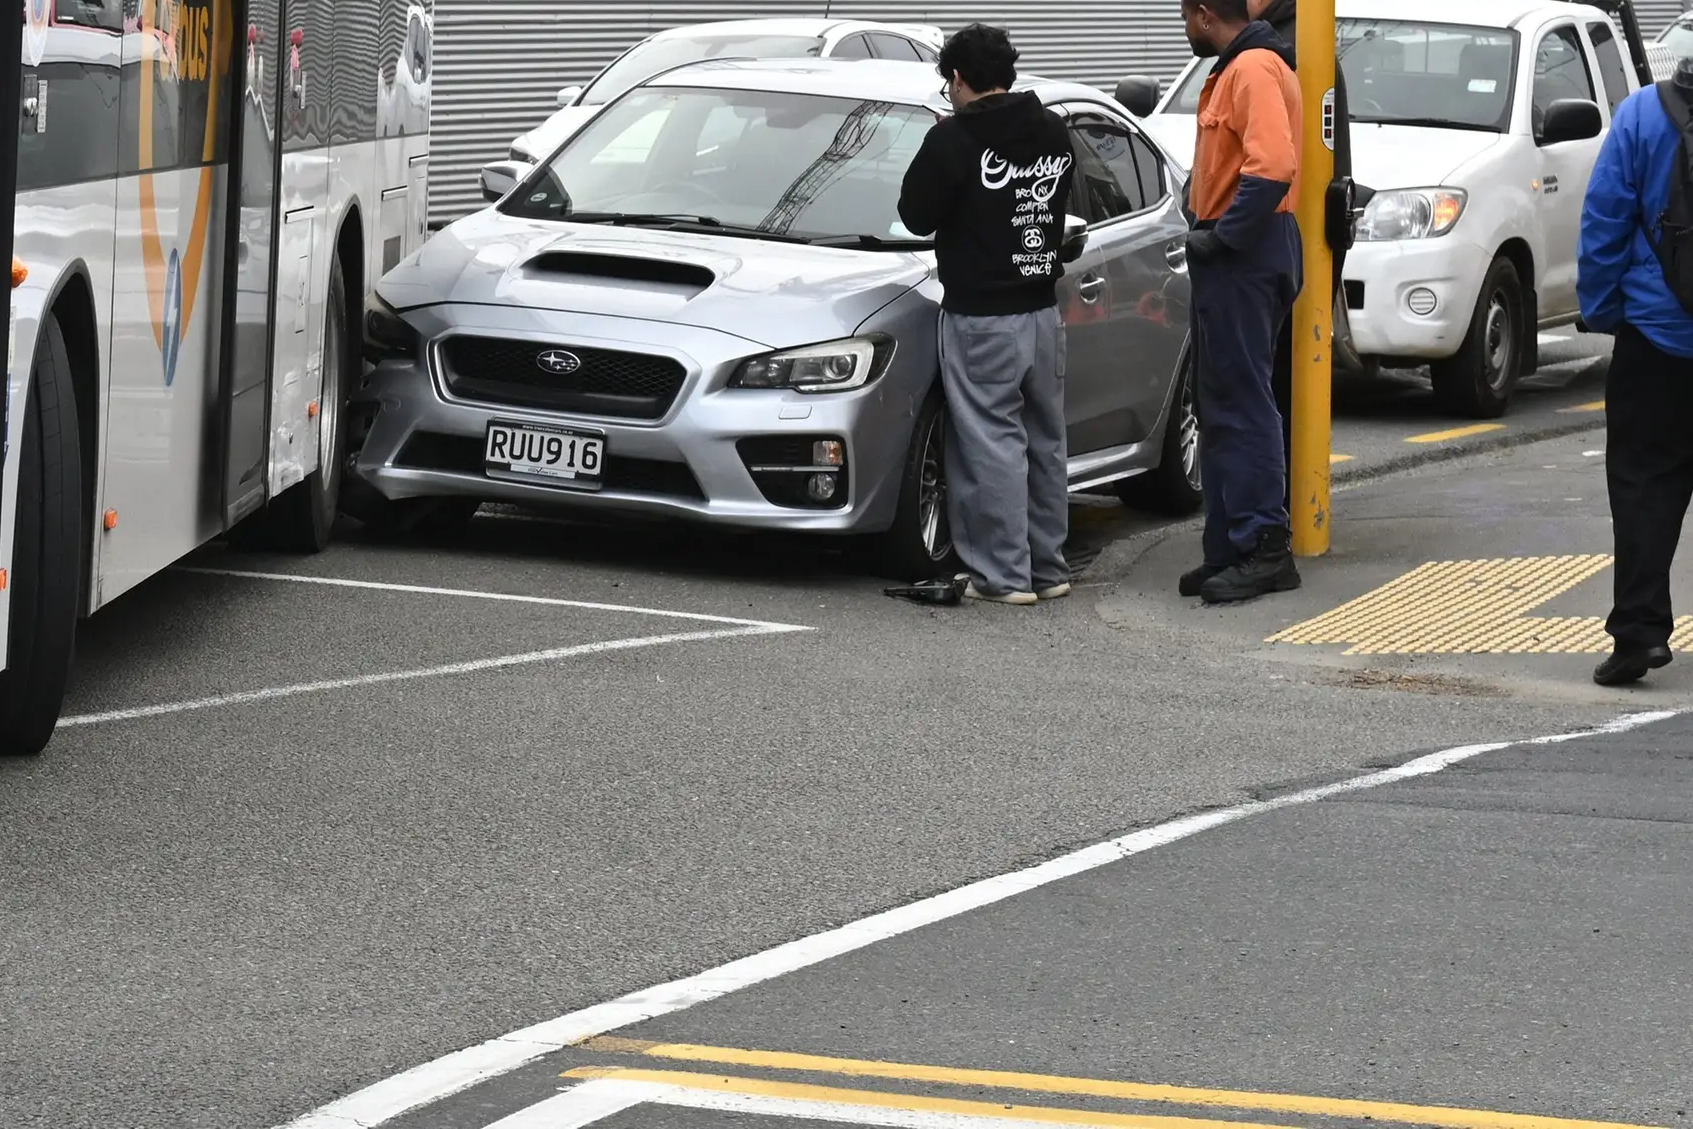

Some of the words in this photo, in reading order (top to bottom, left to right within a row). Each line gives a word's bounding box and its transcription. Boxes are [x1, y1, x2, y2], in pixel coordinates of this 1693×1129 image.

[1015, 201, 1049, 212] COMPTON
[1011, 214, 1034, 226] SANTA
[1036, 214, 1053, 224] ANA
[1012, 250, 1057, 264] BROOKLYN
[490, 429, 598, 470] RUU916
